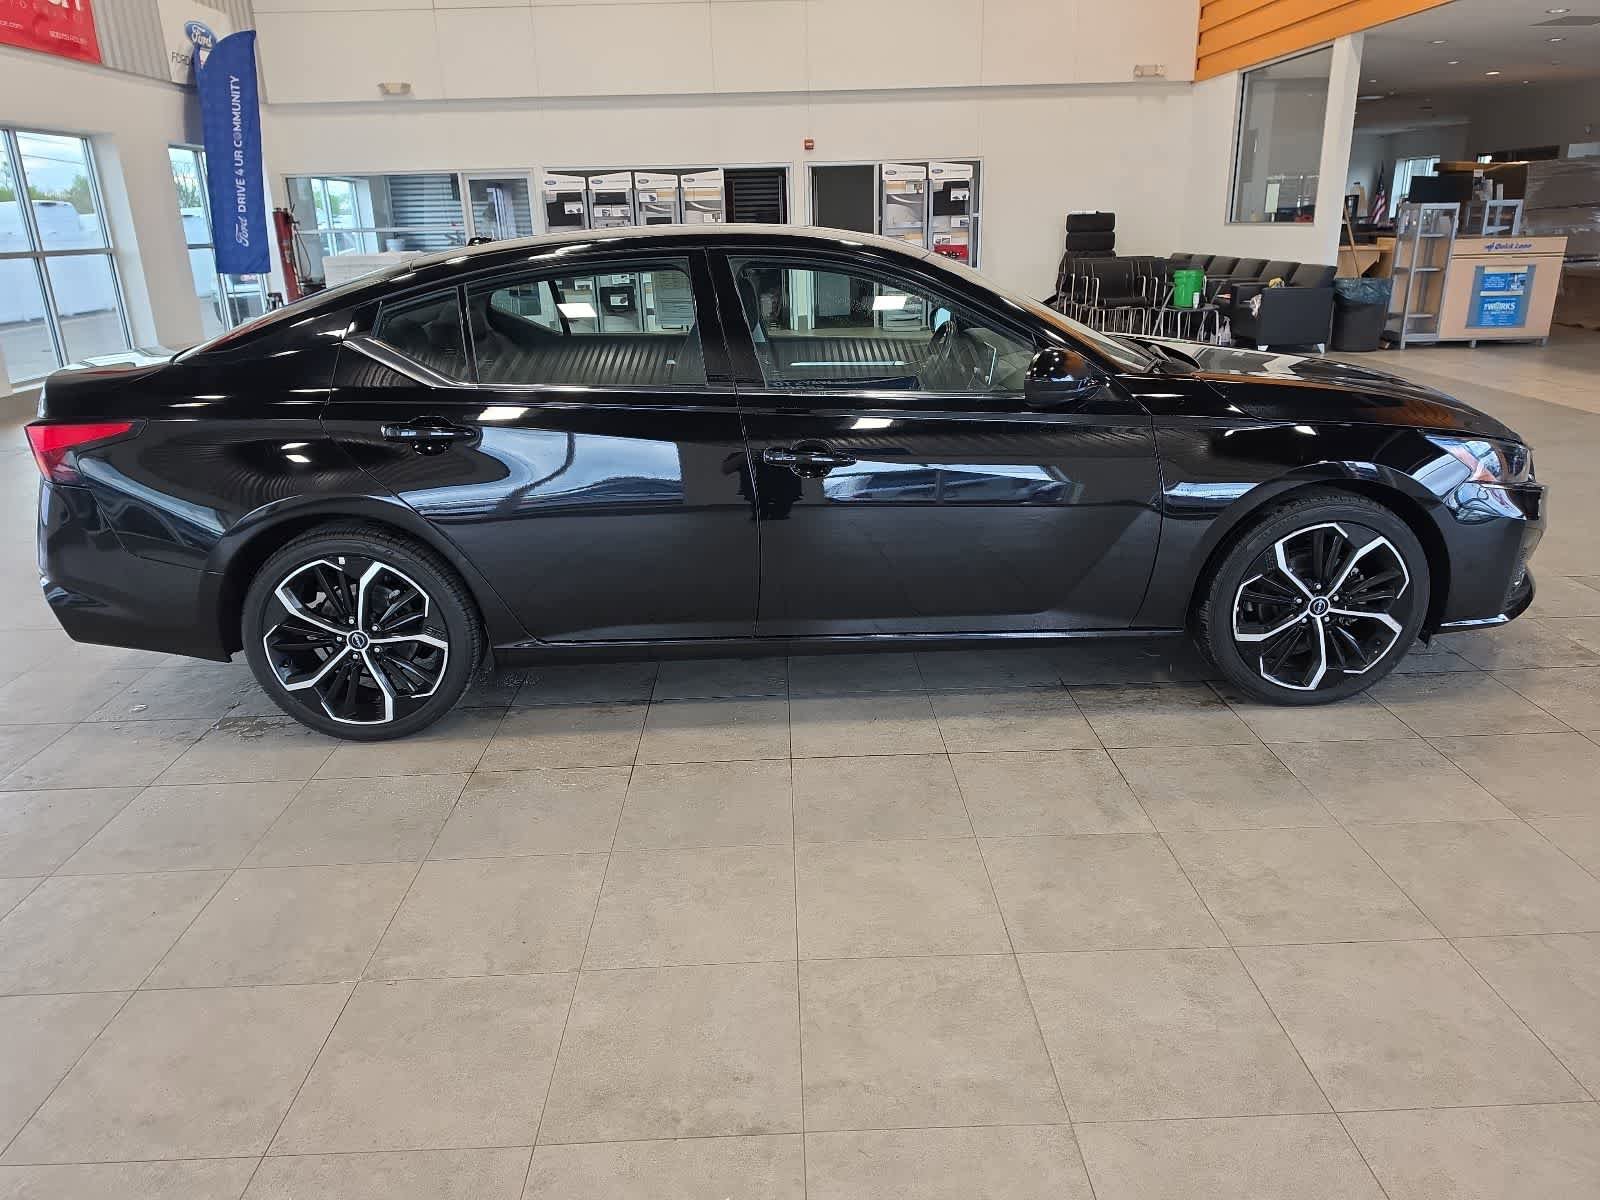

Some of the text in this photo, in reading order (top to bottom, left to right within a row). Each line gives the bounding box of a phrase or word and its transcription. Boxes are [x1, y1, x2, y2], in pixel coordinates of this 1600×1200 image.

[191, 24, 213, 48] Ford
[229, 75, 249, 247] Ford DRIVE 4 UR COMMUNITY
